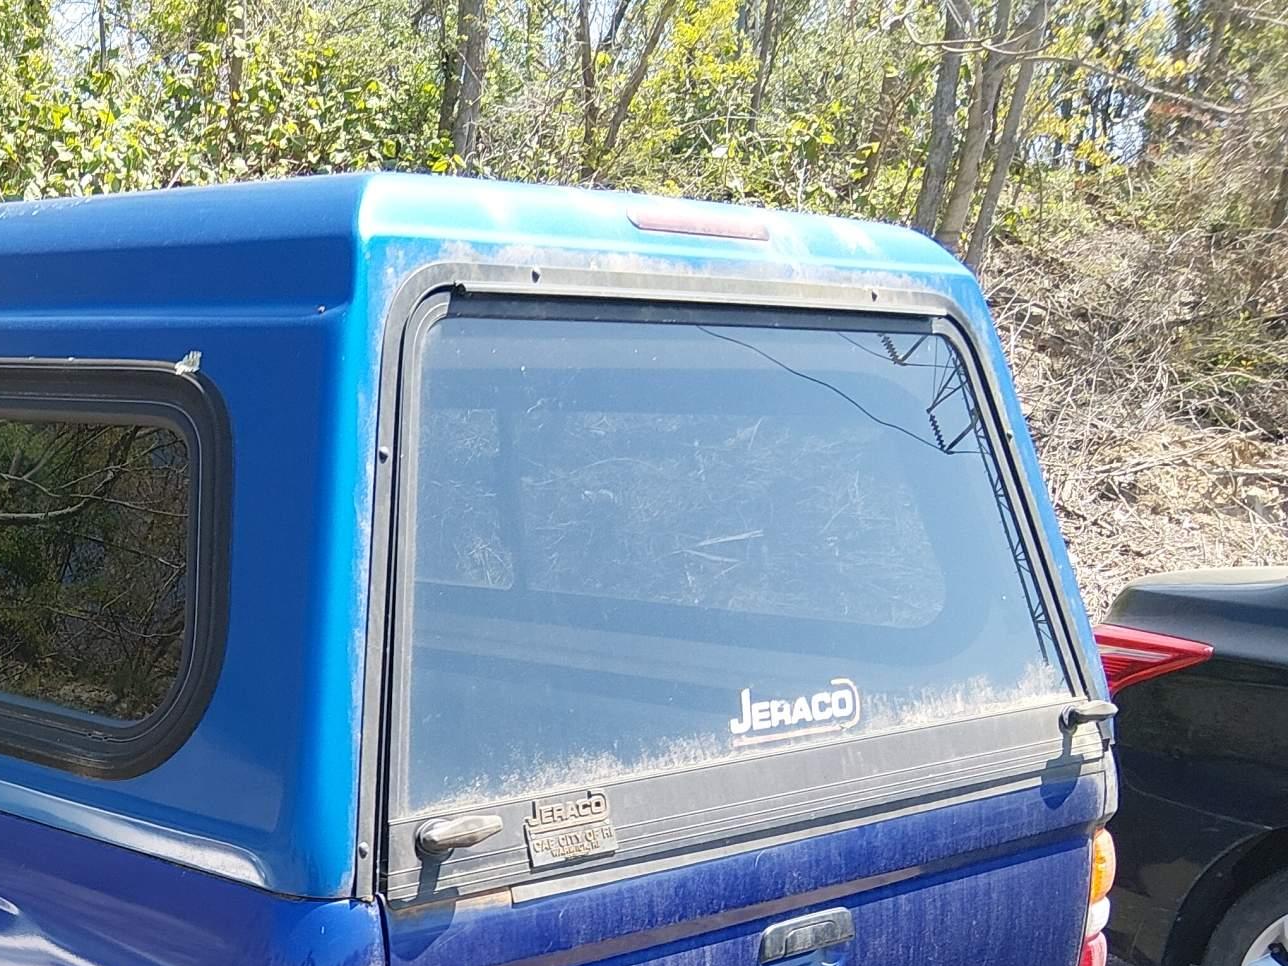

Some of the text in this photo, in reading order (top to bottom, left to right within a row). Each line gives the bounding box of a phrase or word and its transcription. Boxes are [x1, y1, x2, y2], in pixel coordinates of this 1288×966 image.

[728, 679, 860, 735] JERACO
[524, 795, 607, 827] JERACO
[558, 832, 582, 849] CITY
